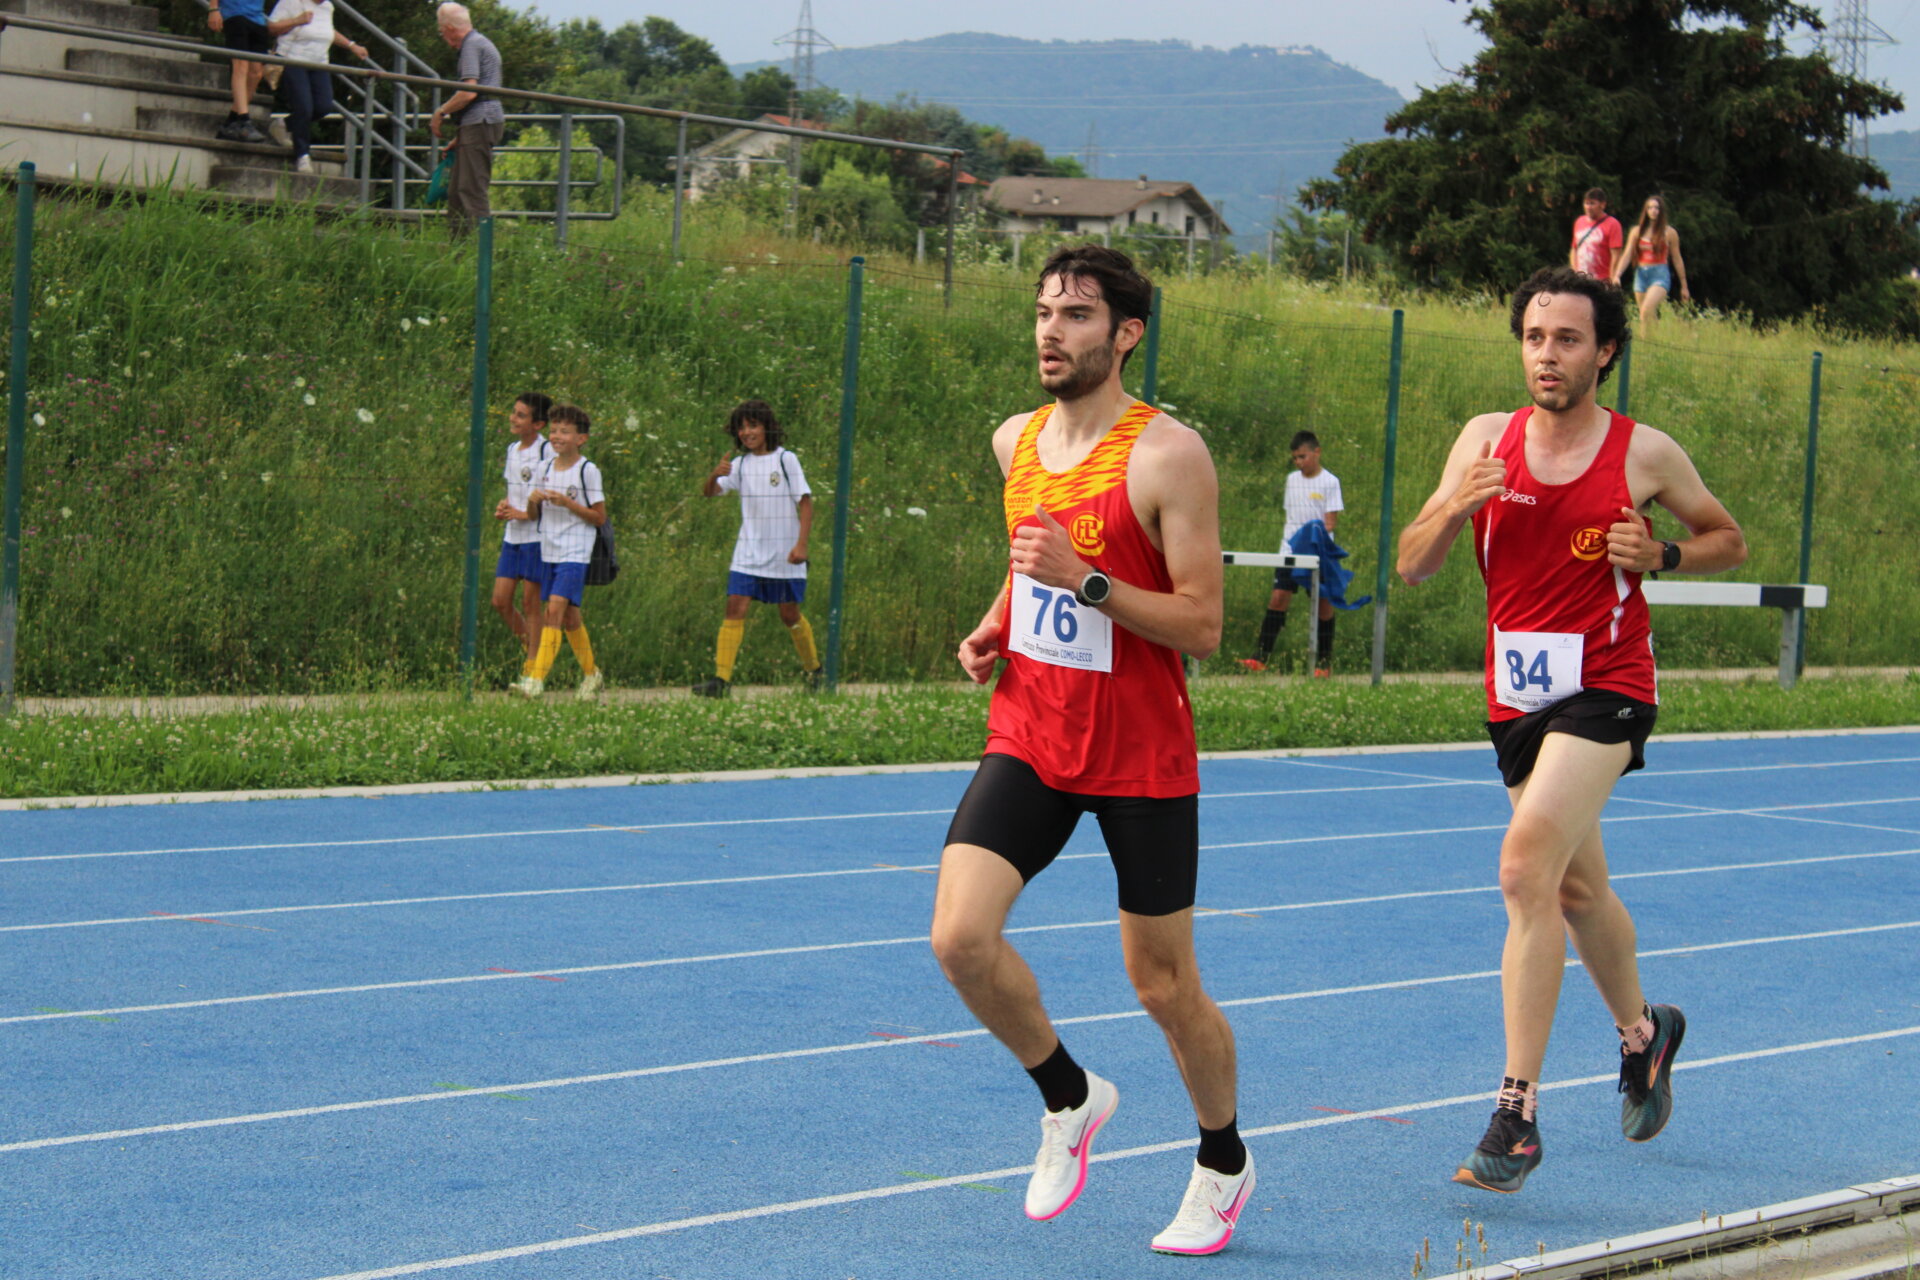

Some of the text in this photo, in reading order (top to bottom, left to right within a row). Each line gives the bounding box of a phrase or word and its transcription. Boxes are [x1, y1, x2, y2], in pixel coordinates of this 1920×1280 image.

[1506, 490, 1536, 505] asics
[1031, 586, 1078, 644] 76
[1505, 649, 1553, 693] 84
